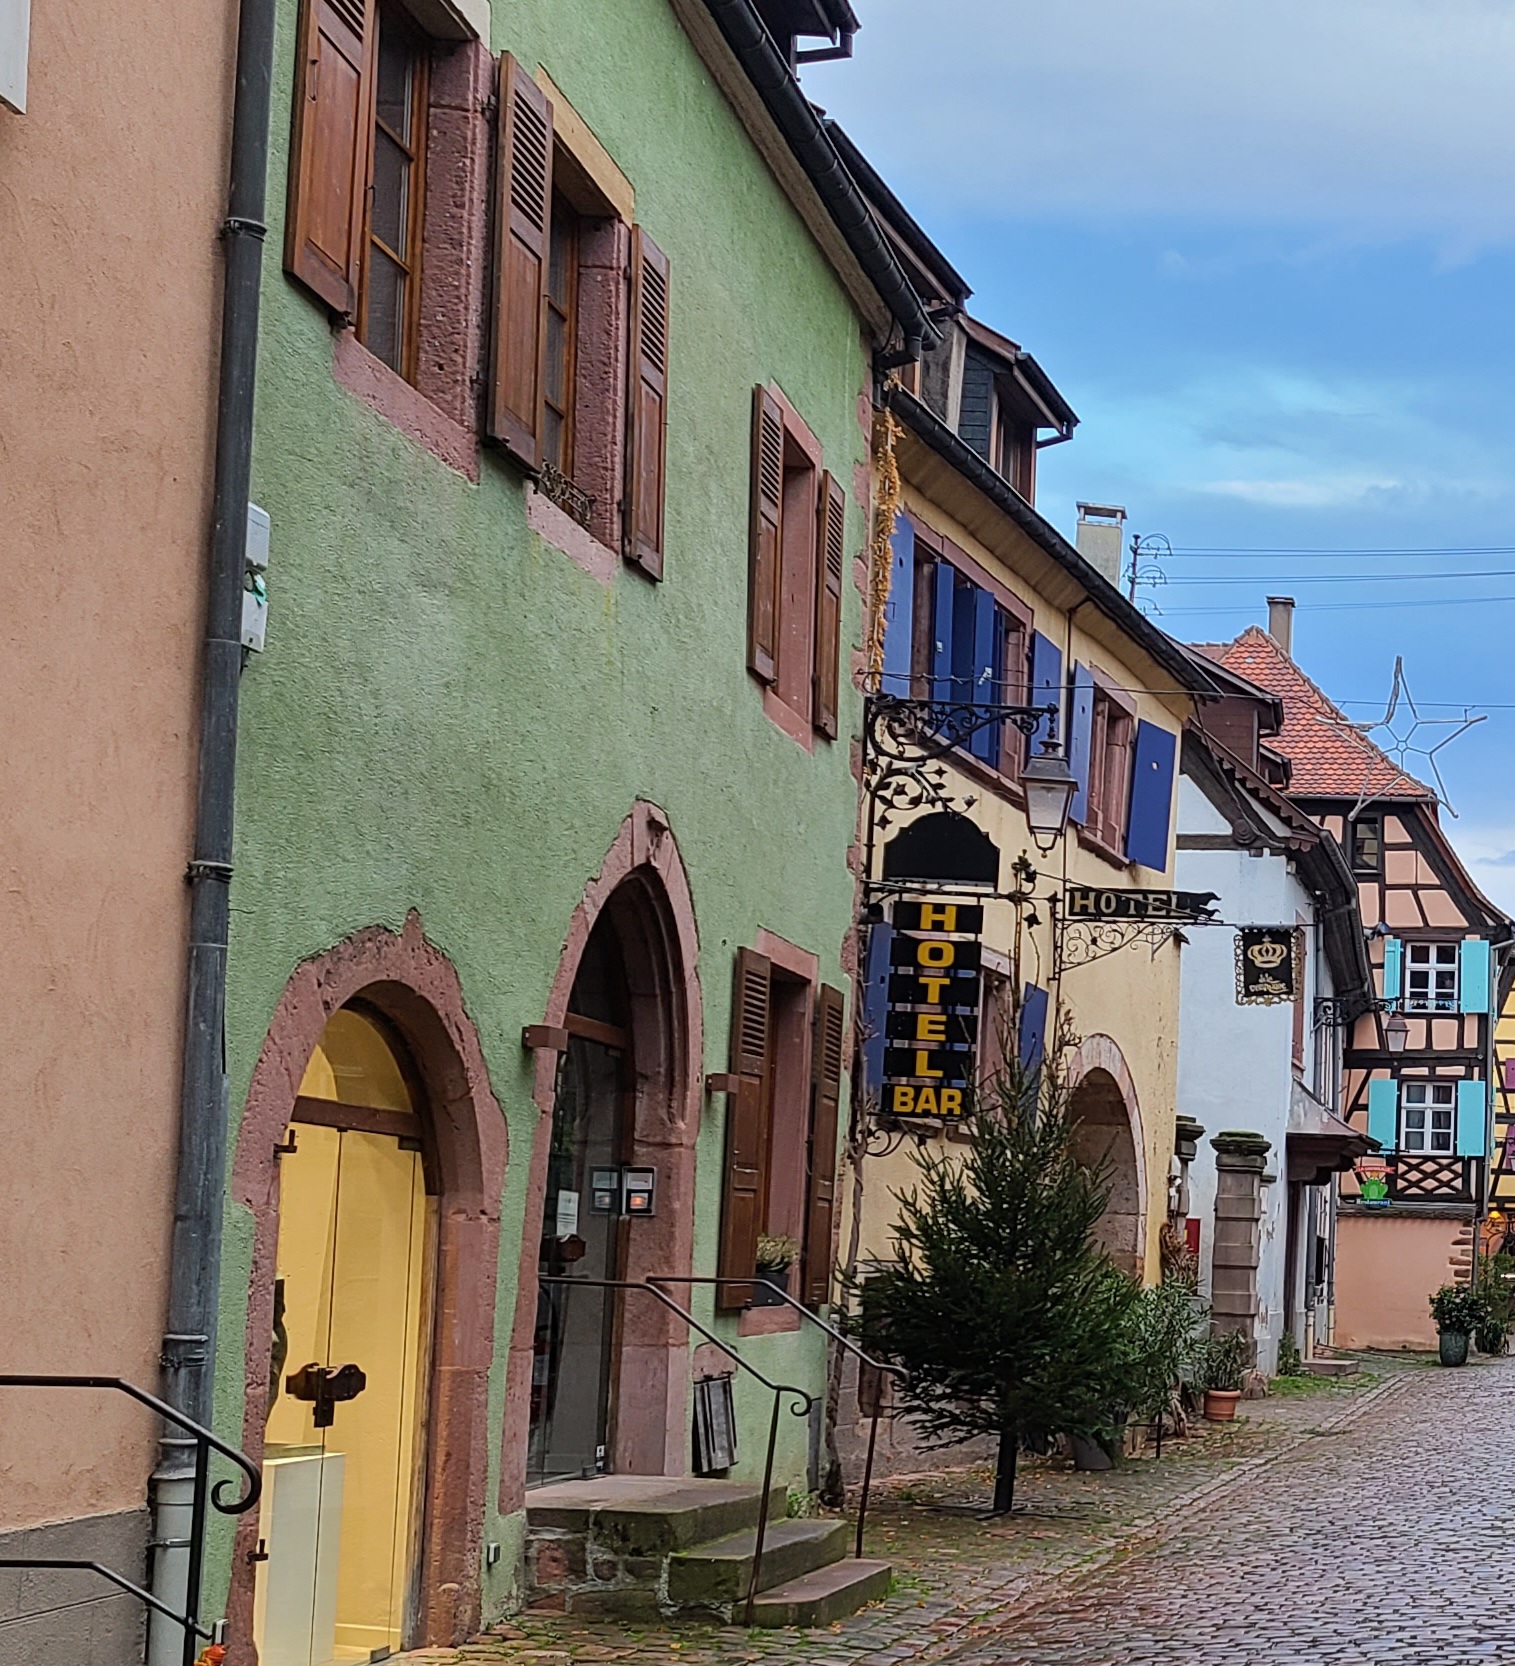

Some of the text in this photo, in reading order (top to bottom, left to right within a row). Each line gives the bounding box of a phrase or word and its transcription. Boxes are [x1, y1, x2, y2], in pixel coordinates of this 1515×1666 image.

[1072, 890, 1191, 917] HOTEL
[915, 903, 957, 1078] HOTEL
[892, 1085, 962, 1115] BAR
